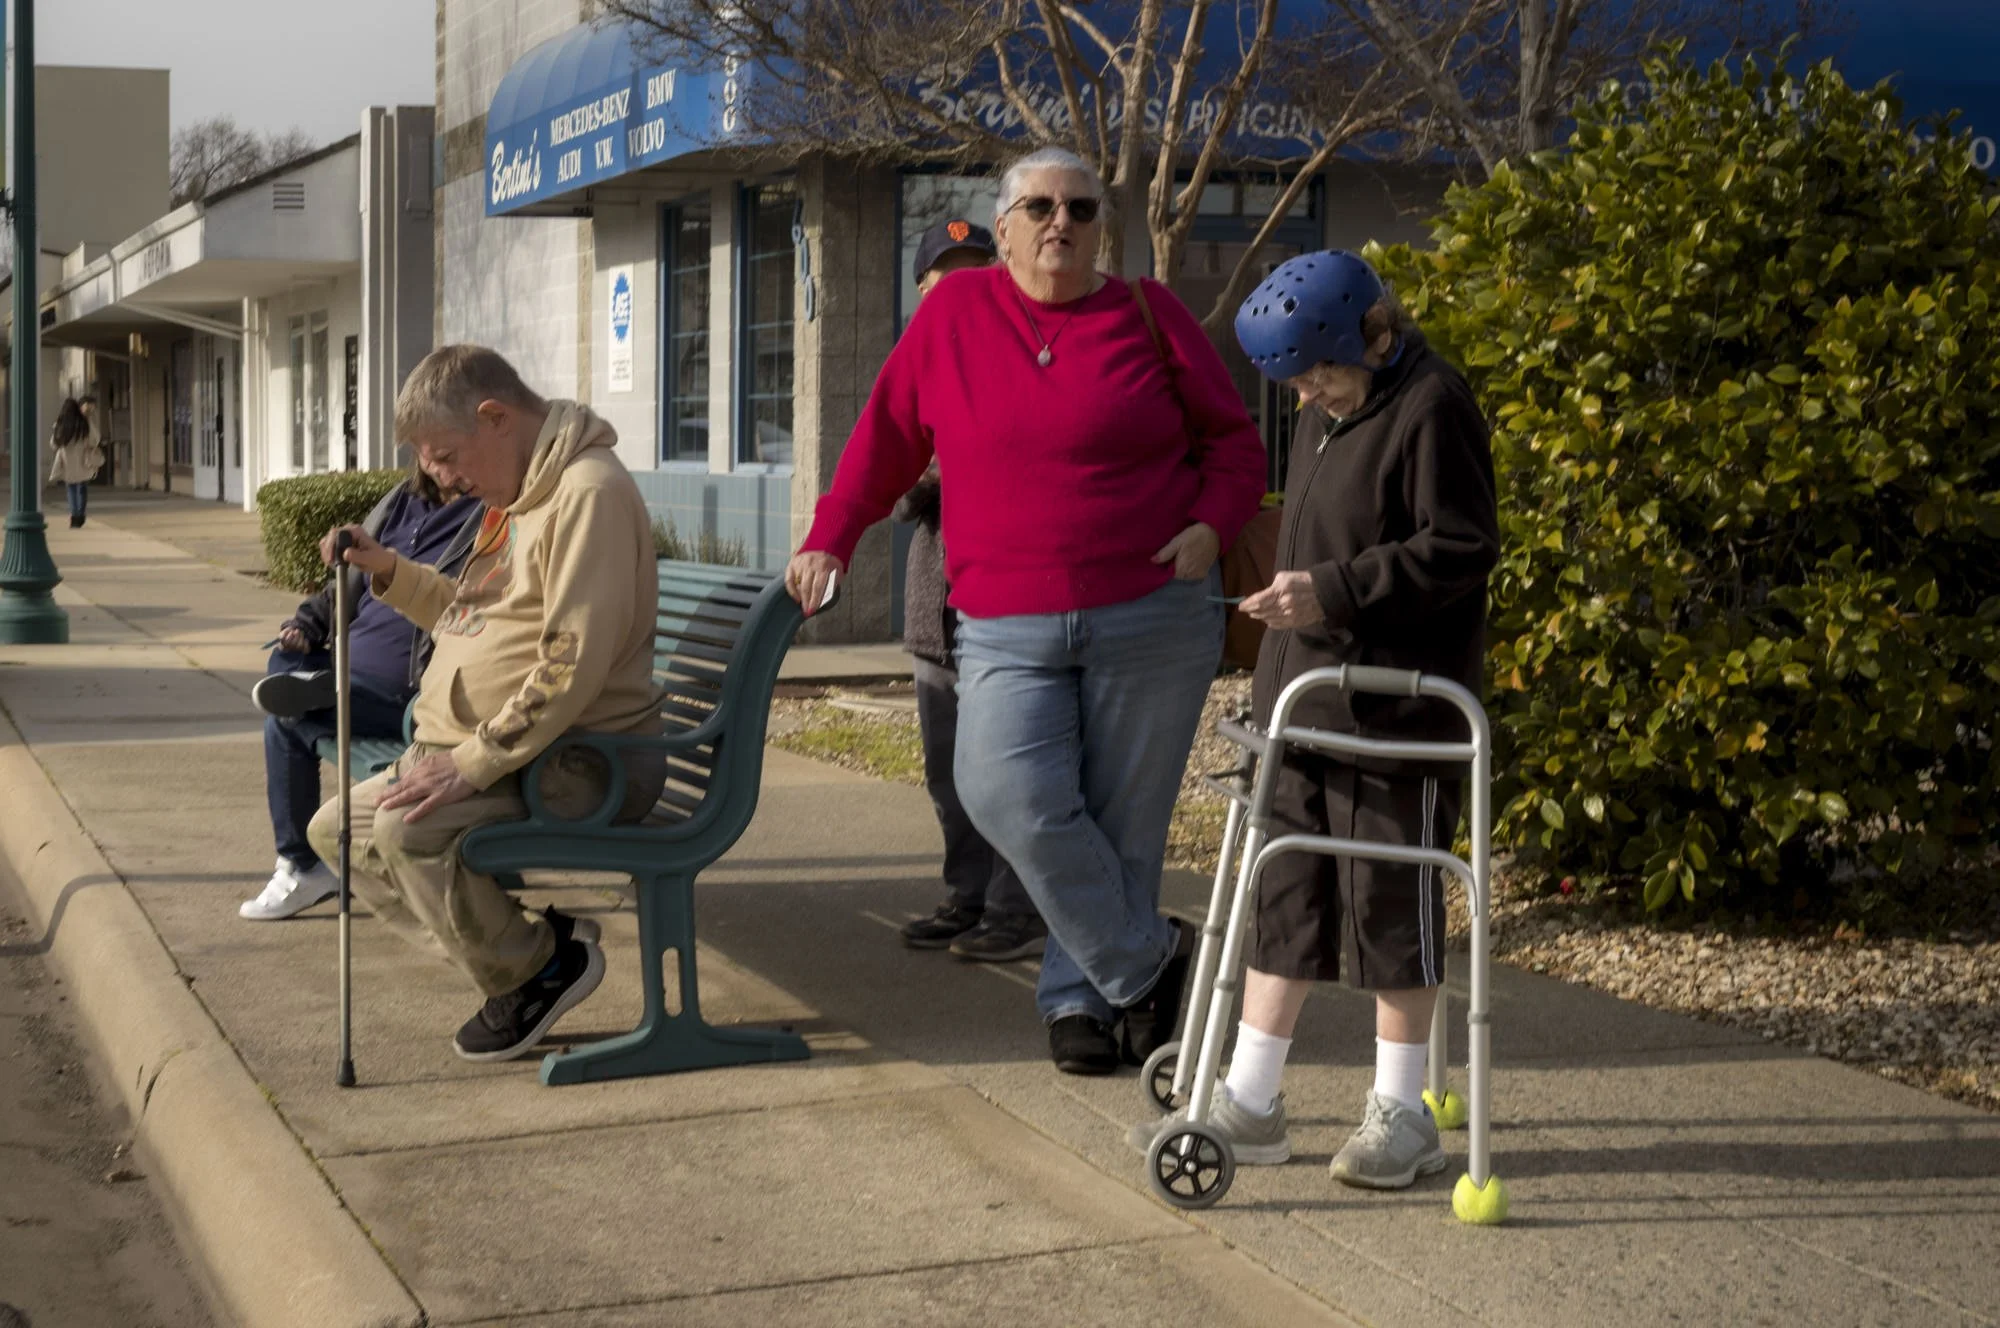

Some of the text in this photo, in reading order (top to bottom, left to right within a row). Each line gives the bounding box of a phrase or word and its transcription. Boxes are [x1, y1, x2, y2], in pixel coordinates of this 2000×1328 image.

[550, 68, 677, 147] MERCEDES-BENZ BMW
[557, 148, 581, 184] AUDI
[628, 117, 665, 158] VOLVO
